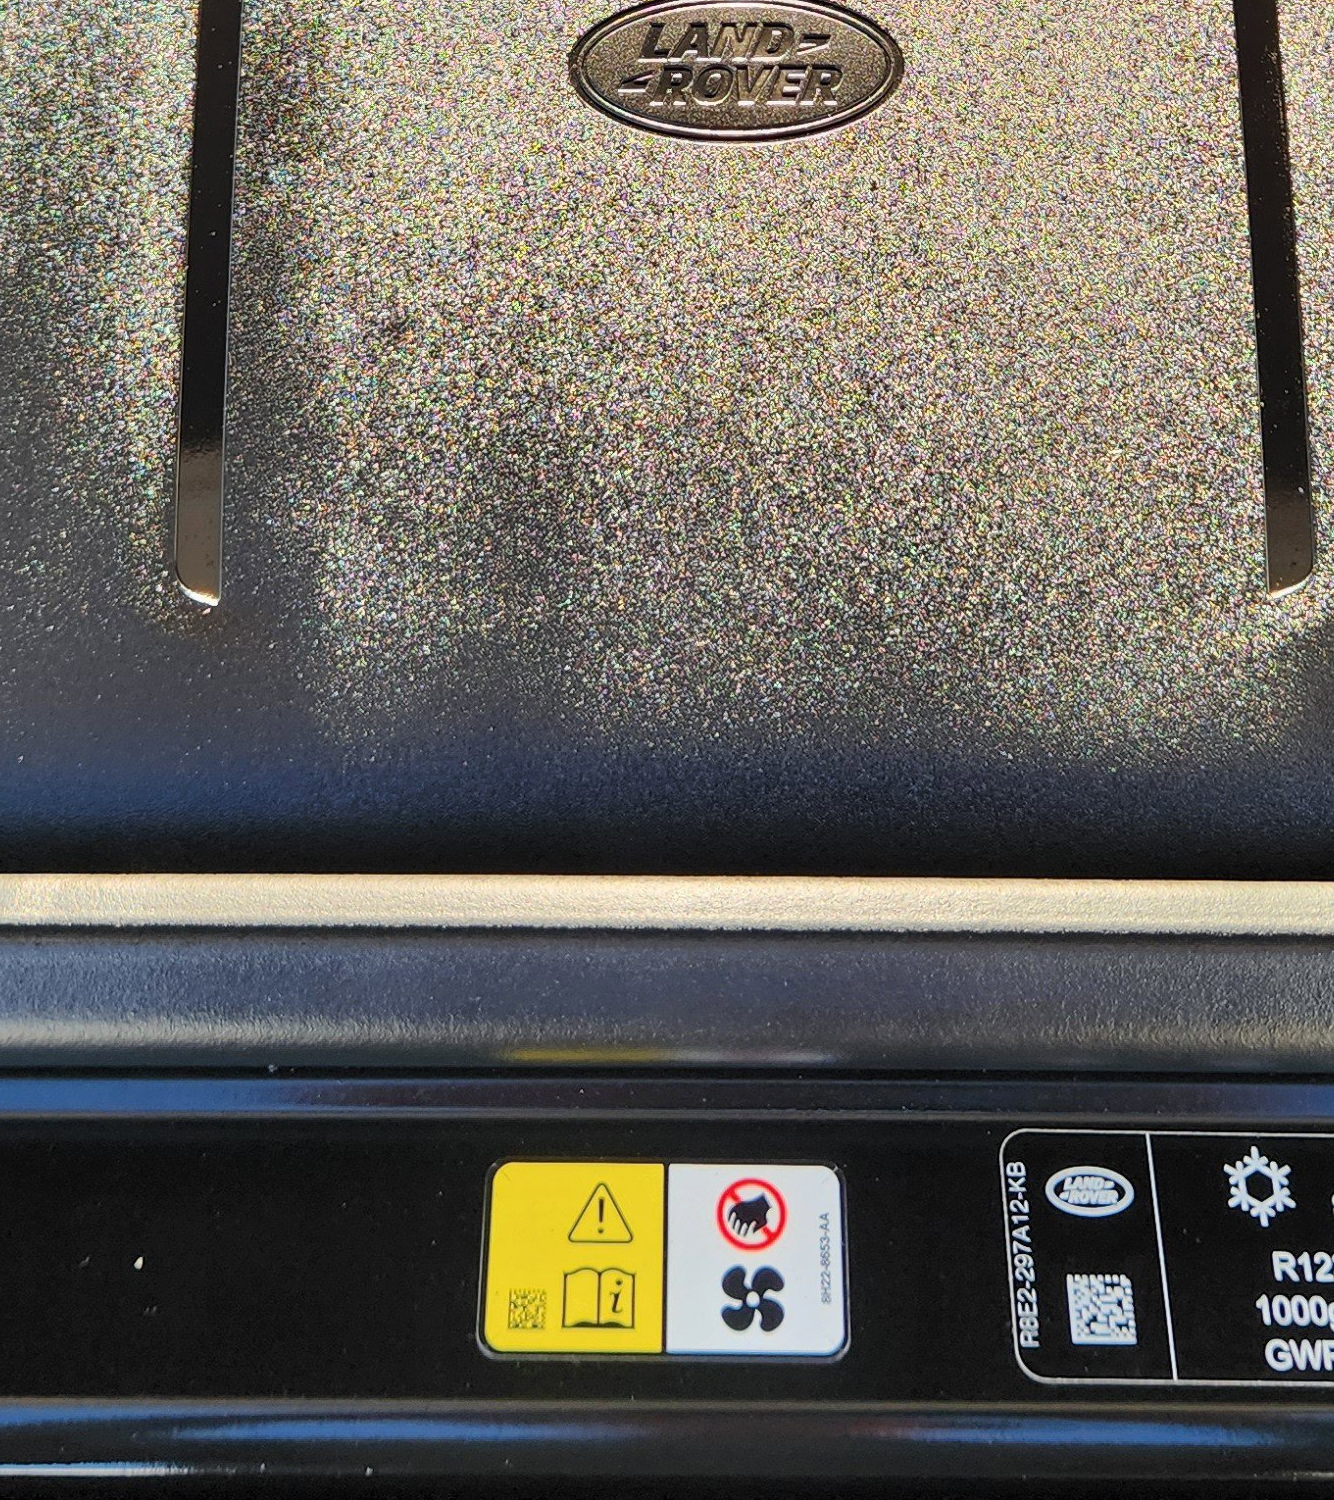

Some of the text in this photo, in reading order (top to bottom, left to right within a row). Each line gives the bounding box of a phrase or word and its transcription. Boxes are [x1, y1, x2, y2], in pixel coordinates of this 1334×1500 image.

[638, 21, 795, 62] LAND
[649, 64, 845, 106] ROVER
[1006, 1160, 1041, 1349] R8E2-297A12-KB
